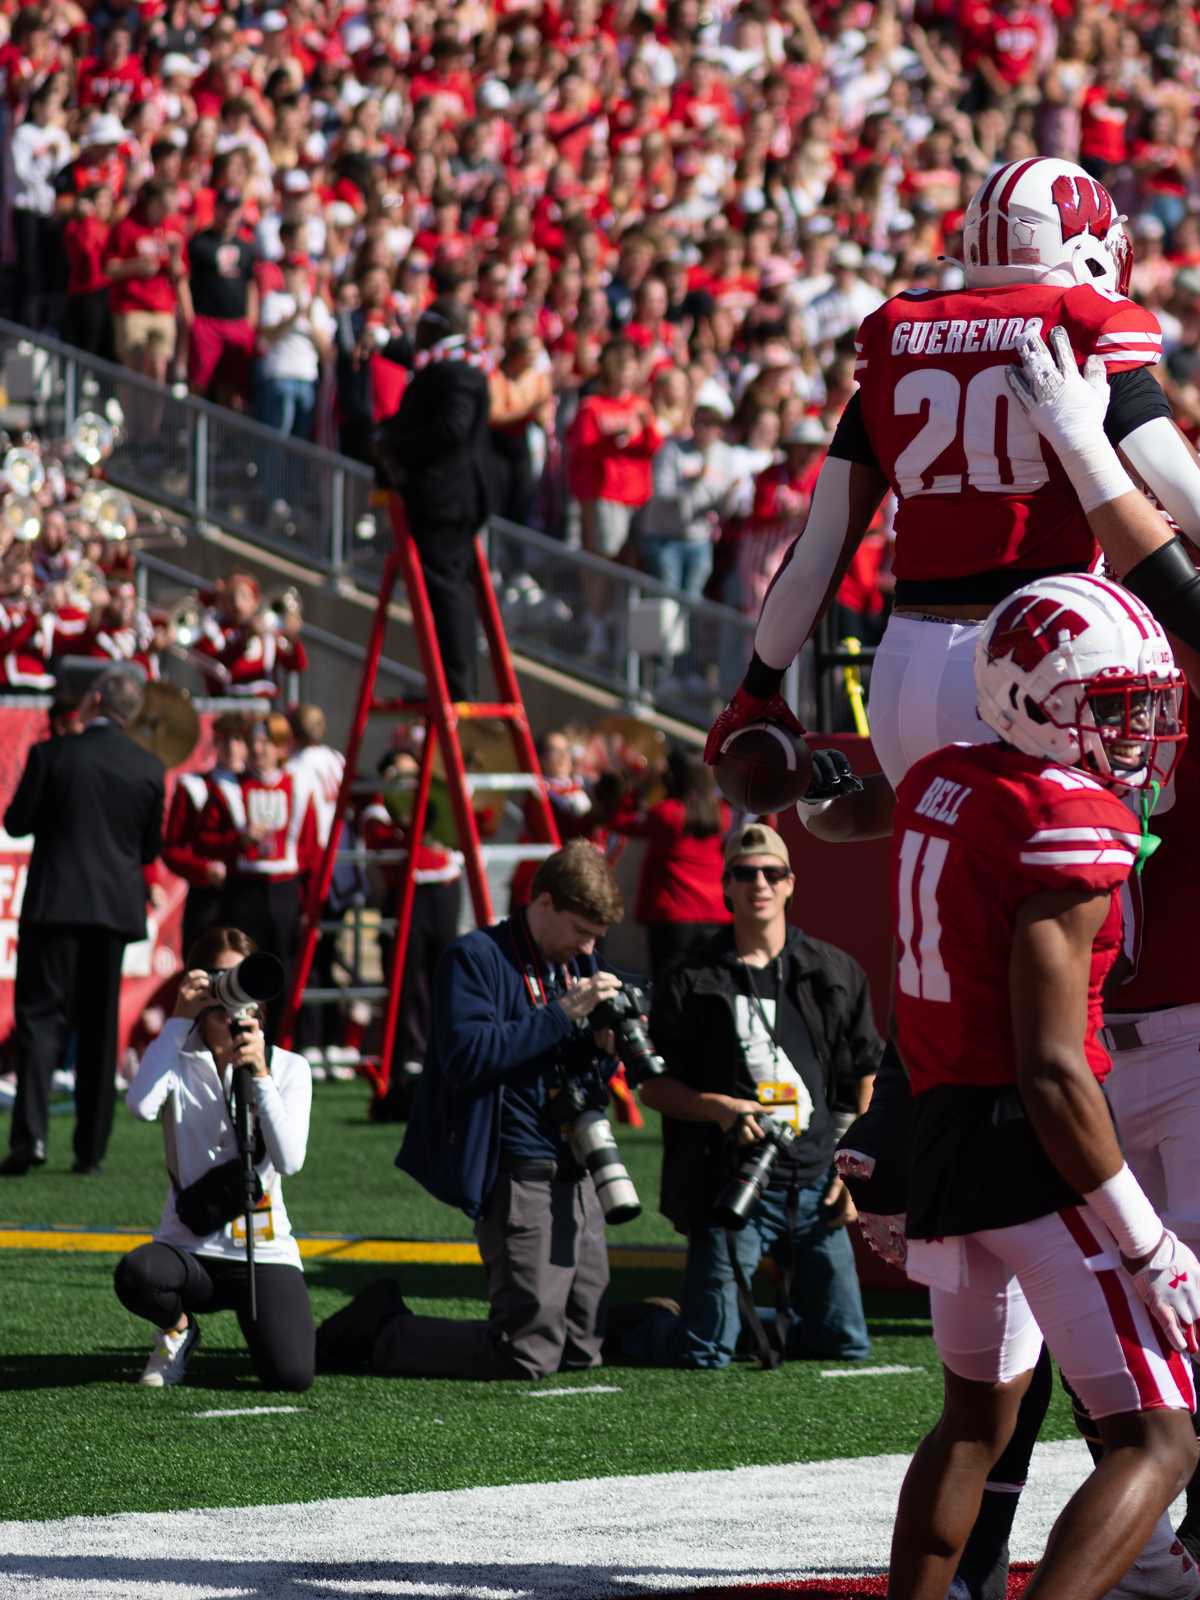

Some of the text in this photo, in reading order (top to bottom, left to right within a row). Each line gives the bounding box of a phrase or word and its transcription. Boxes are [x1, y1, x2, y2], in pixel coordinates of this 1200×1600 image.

[1051, 175, 1113, 245] W
[893, 364, 1050, 499] 20
[988, 595, 1090, 673] W
[915, 776, 972, 825] BELL
[898, 829, 951, 1003] 11
